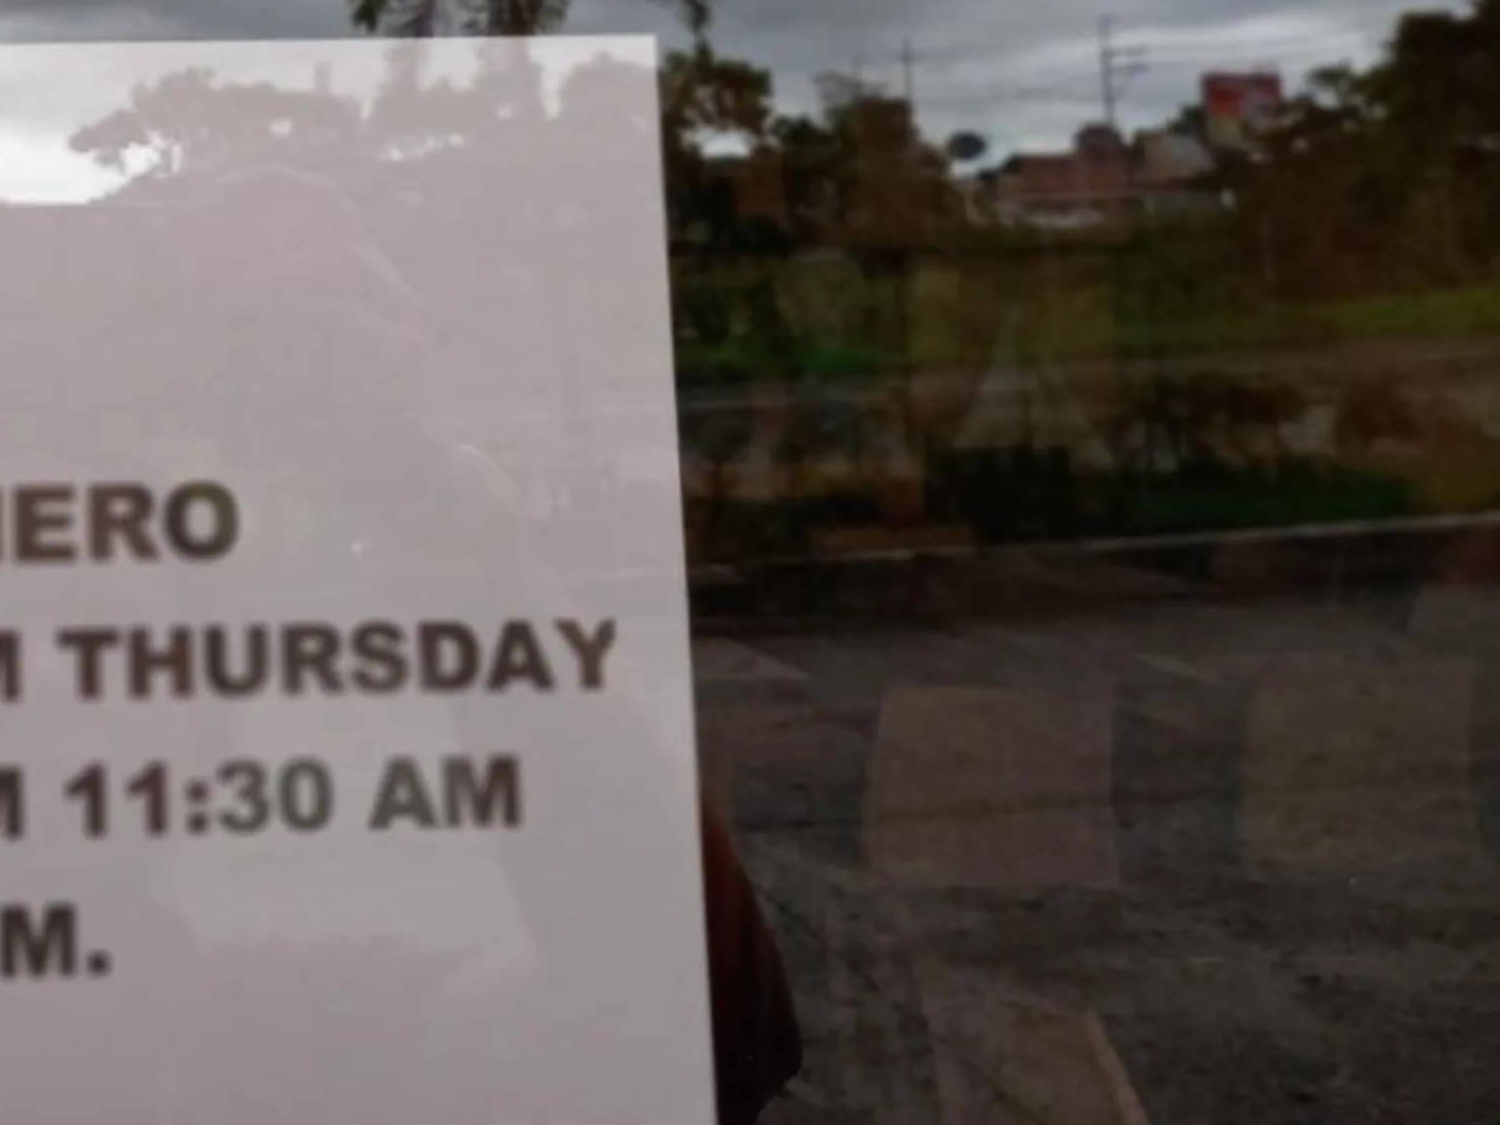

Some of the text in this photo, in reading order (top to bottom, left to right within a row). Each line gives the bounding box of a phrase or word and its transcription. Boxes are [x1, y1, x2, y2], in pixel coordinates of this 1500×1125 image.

[58, 617, 618, 700] THURSDAY
[64, 757, 336, 838] 11:30
[368, 752, 525, 831] AM
